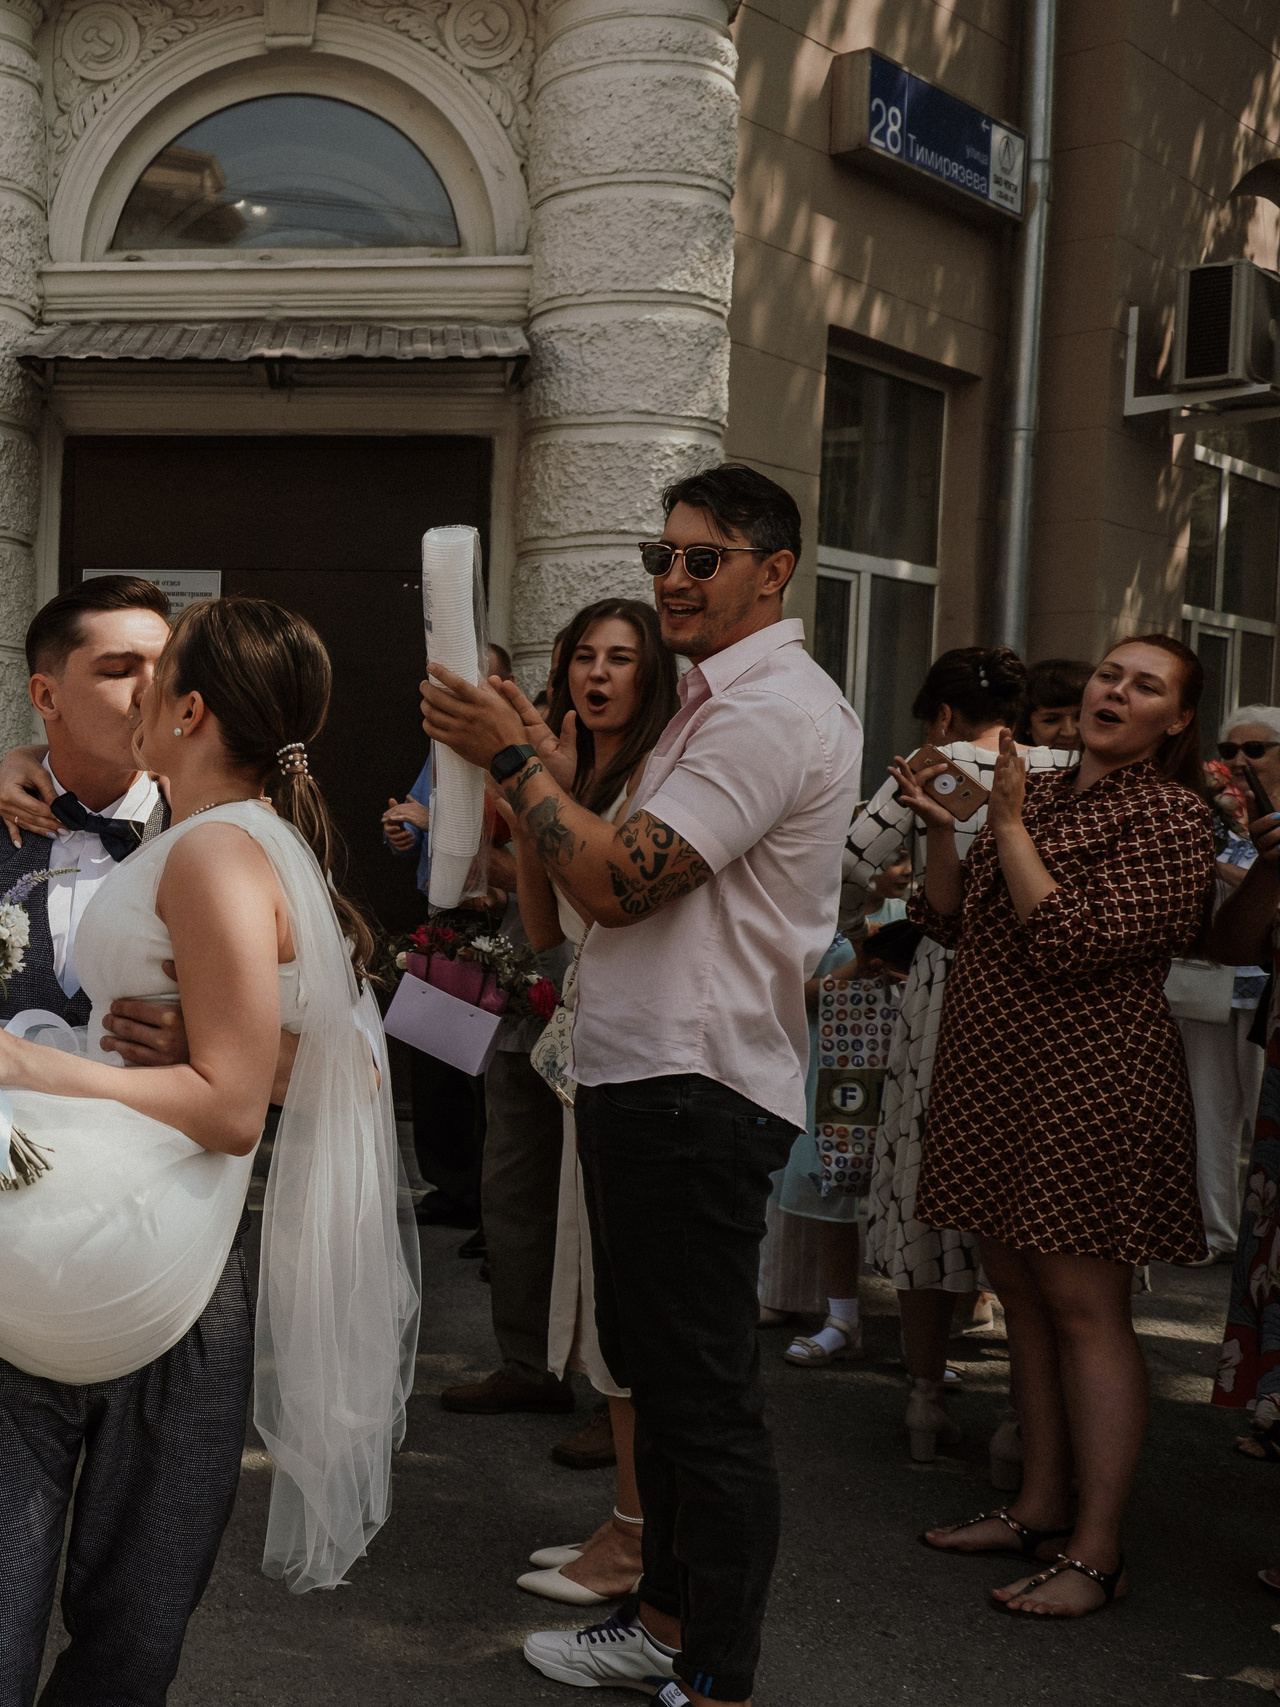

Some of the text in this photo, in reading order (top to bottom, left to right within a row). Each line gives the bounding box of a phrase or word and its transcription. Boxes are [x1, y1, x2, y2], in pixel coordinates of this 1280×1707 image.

[870, 97, 902, 154] 28
[907, 133, 988, 194] Тимирязева
[840, 1086, 858, 1107] F
